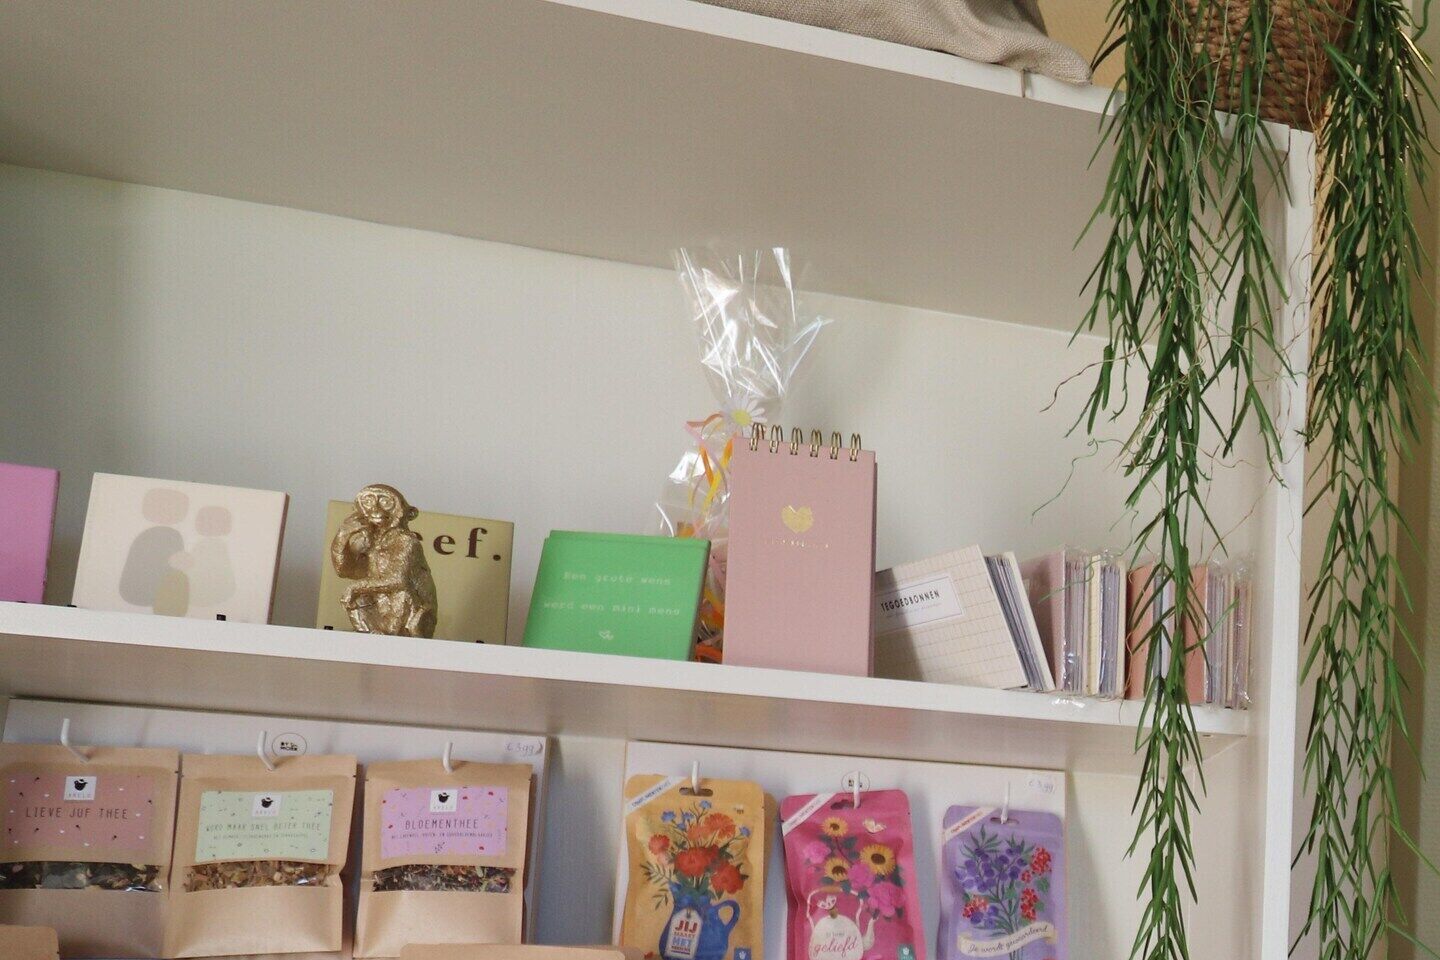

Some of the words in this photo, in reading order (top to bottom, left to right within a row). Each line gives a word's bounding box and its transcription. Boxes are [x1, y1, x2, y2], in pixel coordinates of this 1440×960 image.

[409, 527, 501, 561] ef.
[880, 590, 941, 613] TEGOEDBONNEN
[25, 806, 62, 819] LIEVE
[69, 807, 91, 819] JUF
[99, 808, 129, 820] THEE
[404, 818, 479, 831] BLOEMENTHEE
[675, 920, 698, 934] JIJ
[813, 935, 858, 959] geliefd
